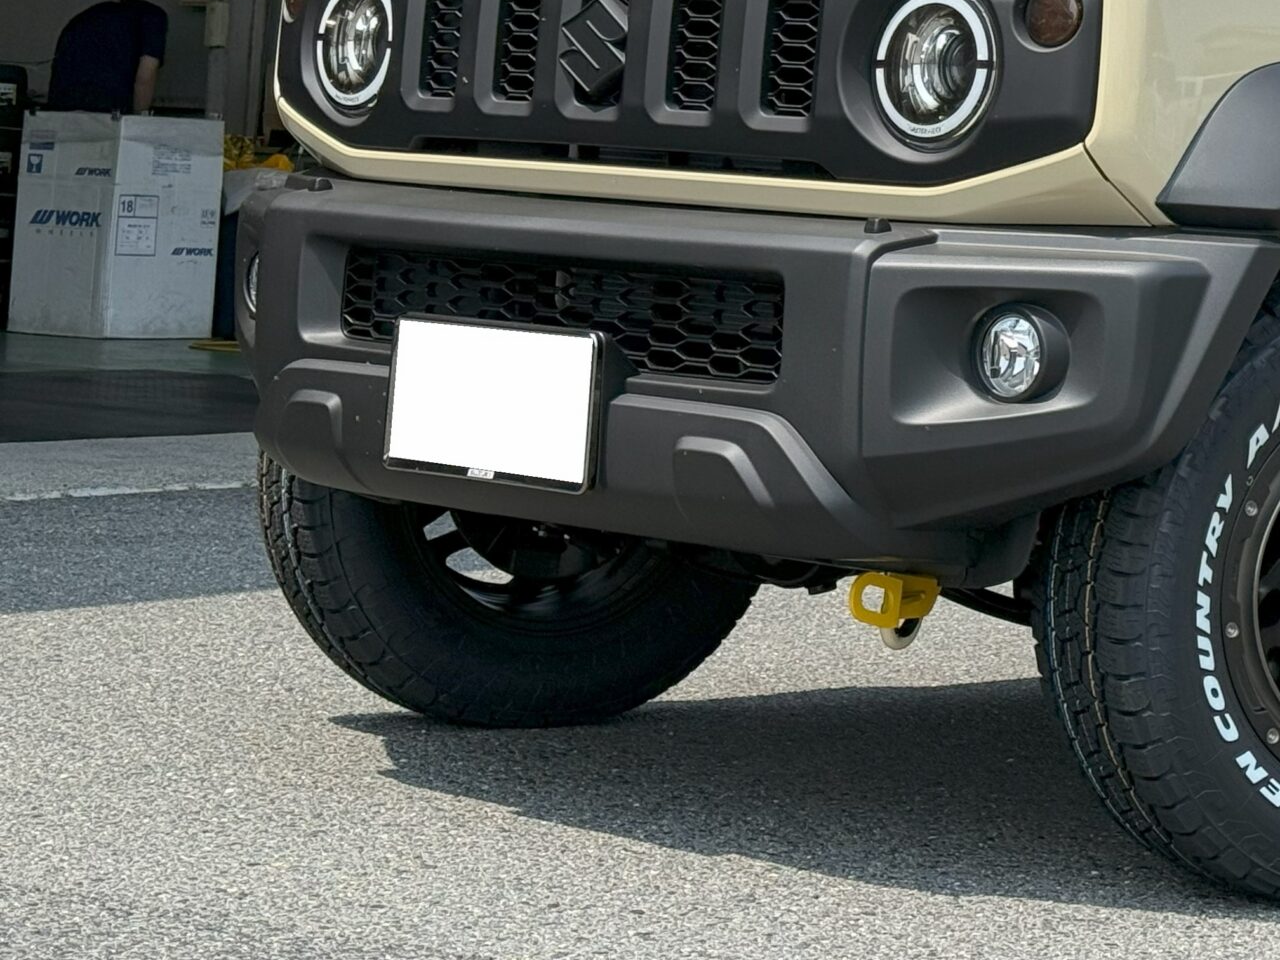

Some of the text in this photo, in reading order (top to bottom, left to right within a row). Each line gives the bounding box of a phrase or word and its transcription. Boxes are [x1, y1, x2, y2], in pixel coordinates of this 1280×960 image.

[87, 168, 112, 177] WORK
[120, 199, 134, 214] 18
[55, 209, 102, 228] WORK
[185, 247, 214, 257] WORK
[1196, 473, 1239, 742] COUNTRY
